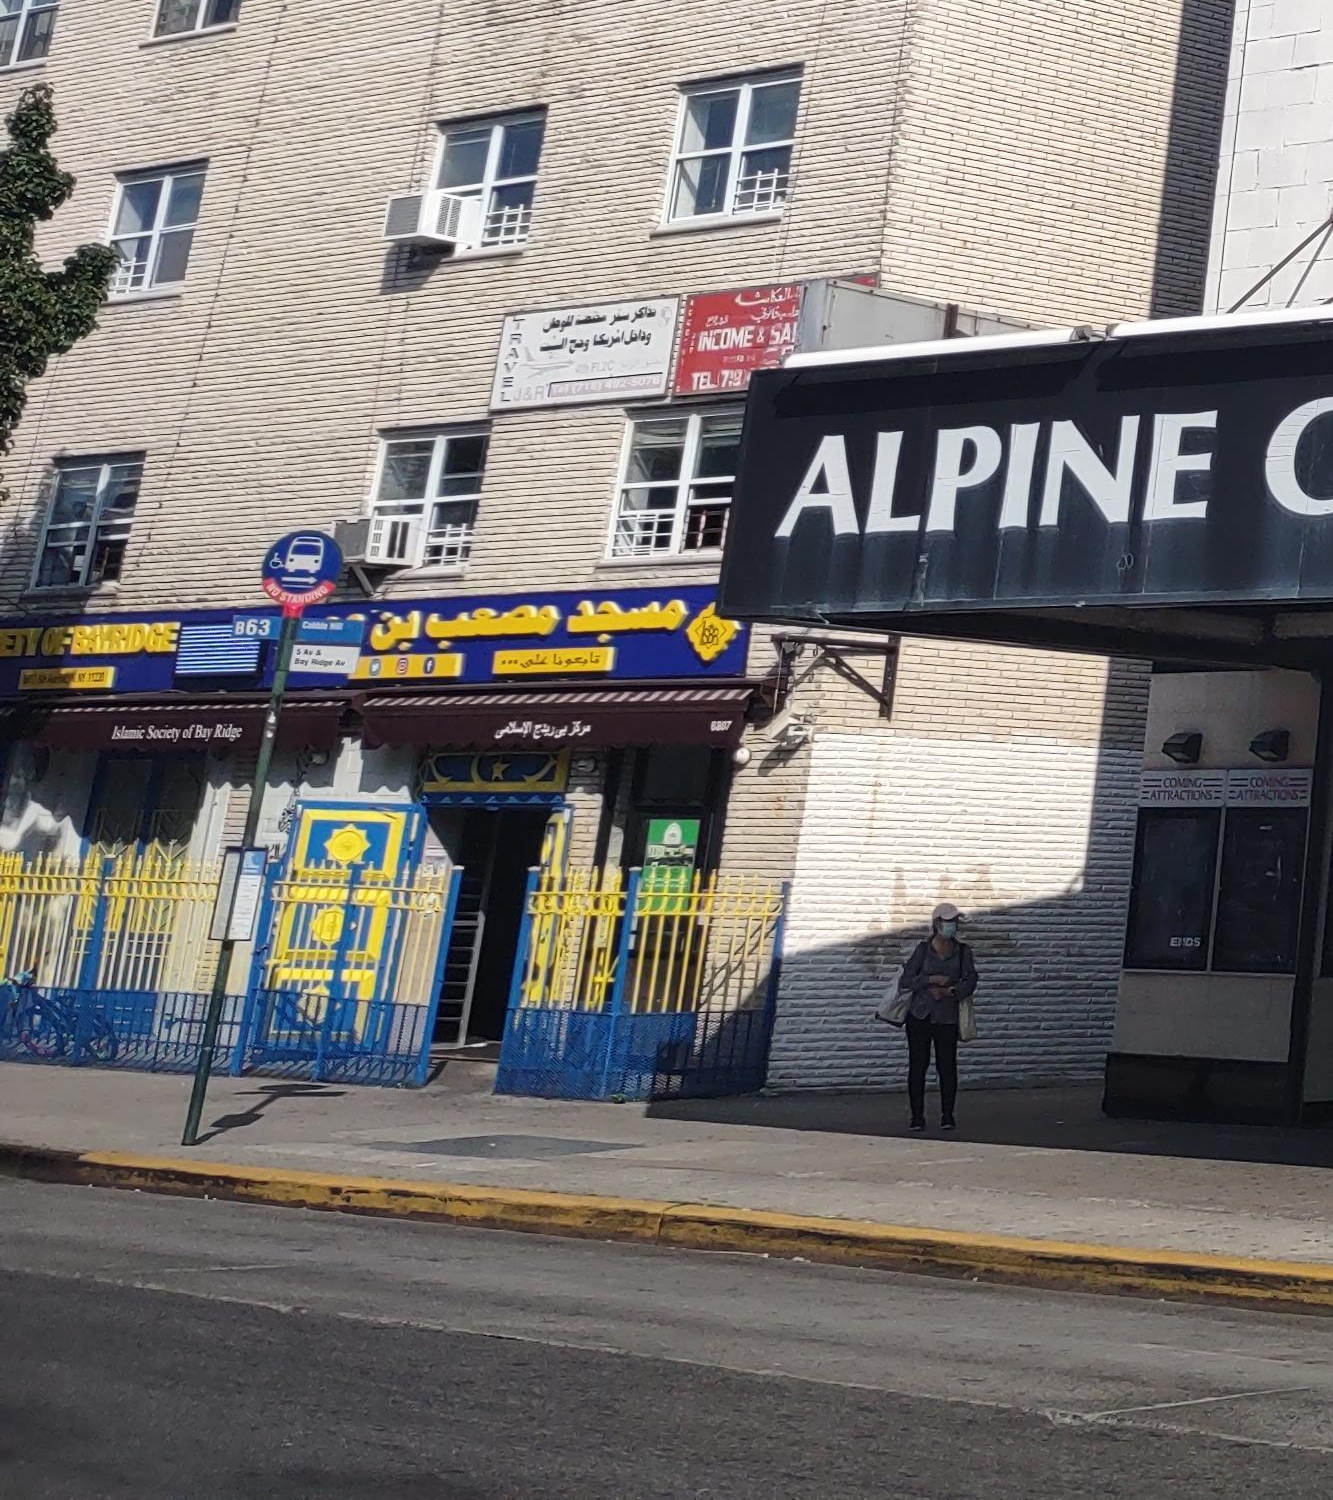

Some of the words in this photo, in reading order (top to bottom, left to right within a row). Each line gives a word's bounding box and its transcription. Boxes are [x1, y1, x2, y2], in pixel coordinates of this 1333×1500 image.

[697, 326, 754, 352] INCOME
[756, 327, 765, 343] &
[500, 316, 526, 402] TRAVEL
[774, 410, 1218, 538] ALPINE
[266, 582, 280, 597] NO
[279, 581, 330, 604] STANDING
[234, 618, 271, 638] B63
[567, 598, 689, 644] مسجد
[294, 657, 309, 667] Bay
[311, 658, 334, 668] Ridge
[111, 725, 145, 740] Islamic
[146, 724, 181, 742] Society
[182, 724, 195, 739] of
[194, 723, 213, 742] Bay
[213, 723, 243, 742] Ridge
[1163, 777, 1203, 789] COMING
[1249, 776, 1289, 788] COMING
[1150, 790, 1214, 801] ATTRACTIONS
[1237, 790, 1300, 801] ATTRACTIONS
[1169, 935, 1202, 948] ENDS
